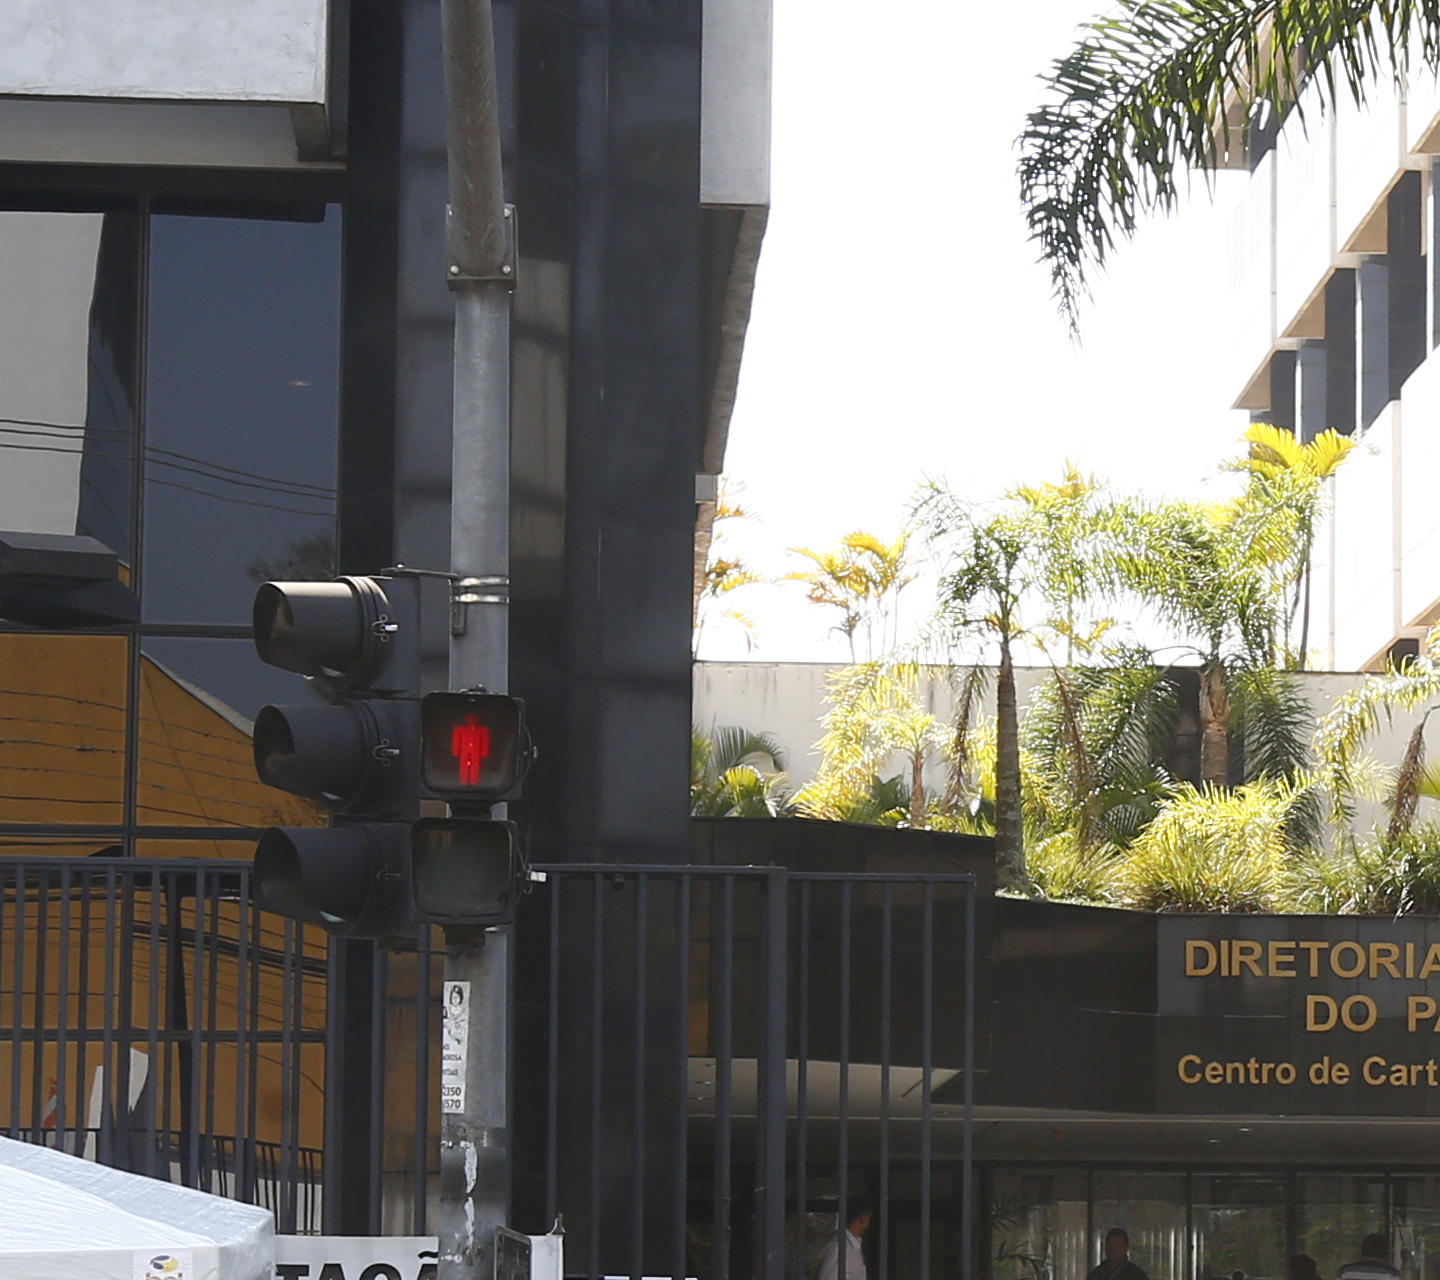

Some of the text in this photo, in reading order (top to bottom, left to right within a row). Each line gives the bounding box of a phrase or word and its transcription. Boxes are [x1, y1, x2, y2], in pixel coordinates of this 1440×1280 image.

[1306, 994, 1378, 1032] DO
[1177, 1054, 1297, 1085] Centro
[1309, 1056, 1350, 1085] de
